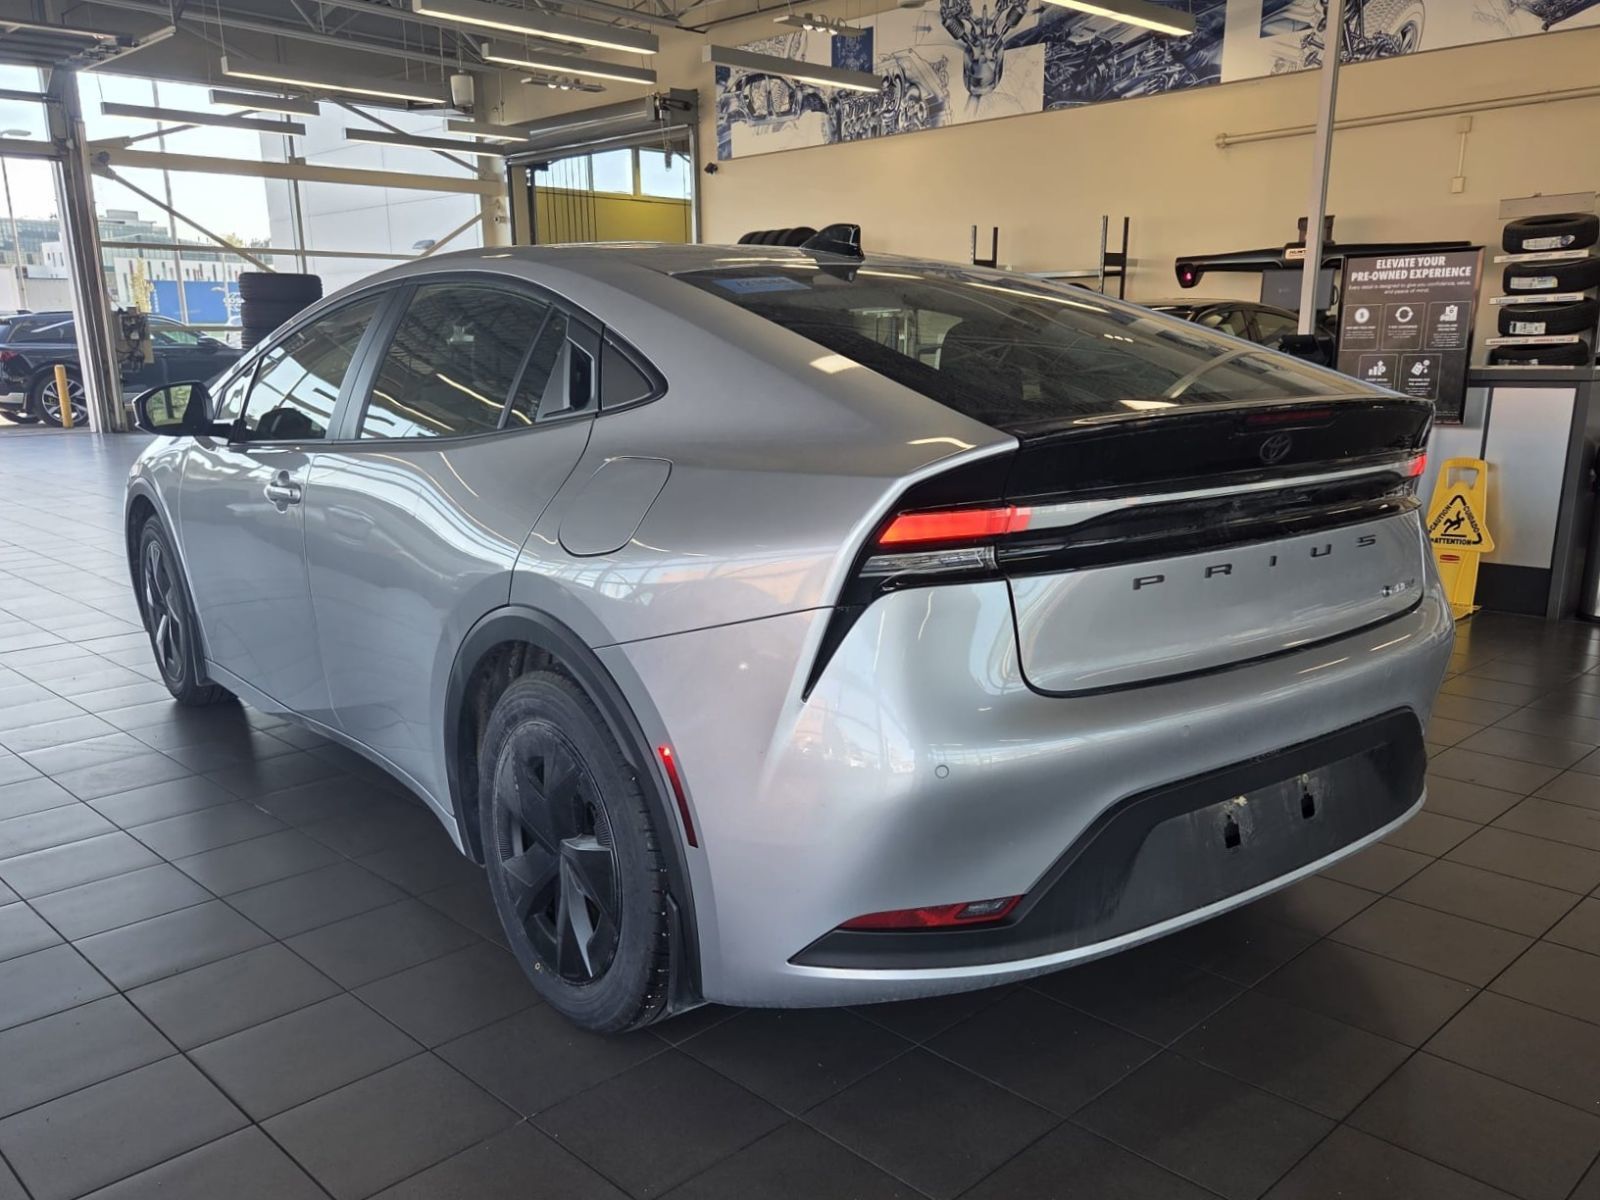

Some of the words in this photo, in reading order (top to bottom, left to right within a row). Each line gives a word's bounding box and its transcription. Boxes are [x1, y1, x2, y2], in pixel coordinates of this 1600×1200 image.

[1351, 269, 1408, 282] PRE-OWNED
[1409, 266, 1472, 279] EXPERIENCE
[1376, 257, 1416, 269] ELEVATE
[1418, 256, 1446, 267] YOUR
[1430, 505, 1451, 531] CAUTION
[1463, 505, 1480, 533] CUIDADO
[1132, 534, 1377, 590] PRIUS
